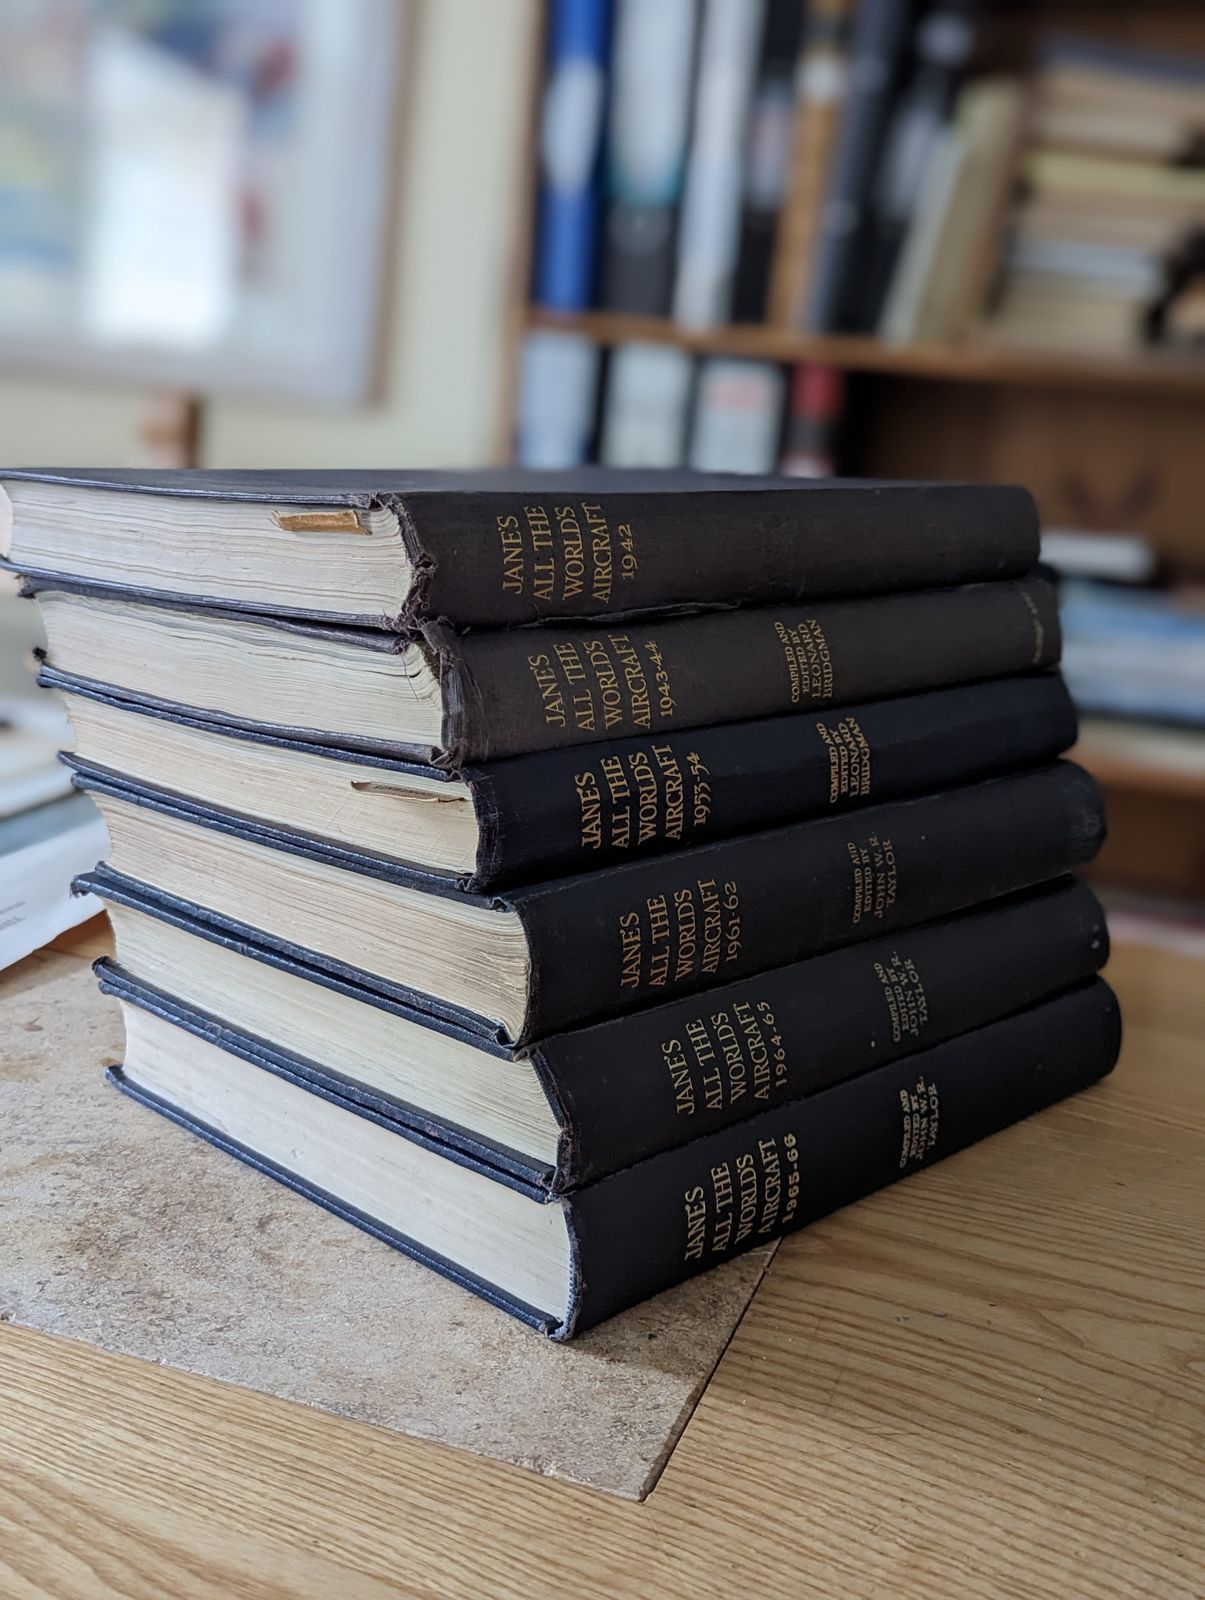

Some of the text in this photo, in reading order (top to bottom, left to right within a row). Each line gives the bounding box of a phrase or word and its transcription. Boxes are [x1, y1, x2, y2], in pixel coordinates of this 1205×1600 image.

[497, 515, 524, 595] JANE'S
[524, 506, 555, 600] ALL THE
[554, 506, 585, 601] WORLD'S
[581, 502, 612, 604] AIRCRAFT
[618, 524, 638, 580] 1942
[527, 654, 566, 728] JANE'S
[553, 642, 595, 731] ALL THE
[583, 640, 623, 730] WORLD'S
[608, 634, 650, 729] AIRCRAFT
[644, 641, 677, 718] 1943-44
[774, 622, 800, 702] COMPILED AND
[787, 628, 809, 694] EDITED BY
[799, 624, 821, 698] LEONARD
[806, 619, 832, 698] BRIDGMAN
[628, 752, 657, 845] WORLD'S
[651, 745, 684, 840] AIRCRAFT
[687, 752, 711, 827] 1953-54
[838, 723, 859, 797] LEONARD
[845, 717, 870, 796] BRIDGMAN
[574, 771, 601, 849] JANE'S
[600, 755, 630, 848] ALL THE
[874, 873, 885, 918] JOHN
[883, 839, 896, 907] TAYLOR
[619, 912, 641, 988] JANE'S
[647, 895, 670, 986] ALL THE
[674, 889, 696, 981] WORLD'S
[697, 878, 721, 973] AIRCRAFT
[723, 881, 742, 961] 1961-62
[662, 1039, 695, 1115] JANE'S
[685, 1018, 722, 1110] ALL THE
[711, 1012, 746, 1104] WORLD'S
[733, 1001, 770, 1099] AIRCRAFT
[757, 1001, 787, 1086] 1964-65
[711, 1162, 732, 1251] ALL THE
[735, 1153, 757, 1244] WORLD'S
[758, 1137, 781, 1233] AIRCRAFT
[783, 1133, 800, 1223] 1965-66
[684, 1186, 706, 1260] JANE'S
